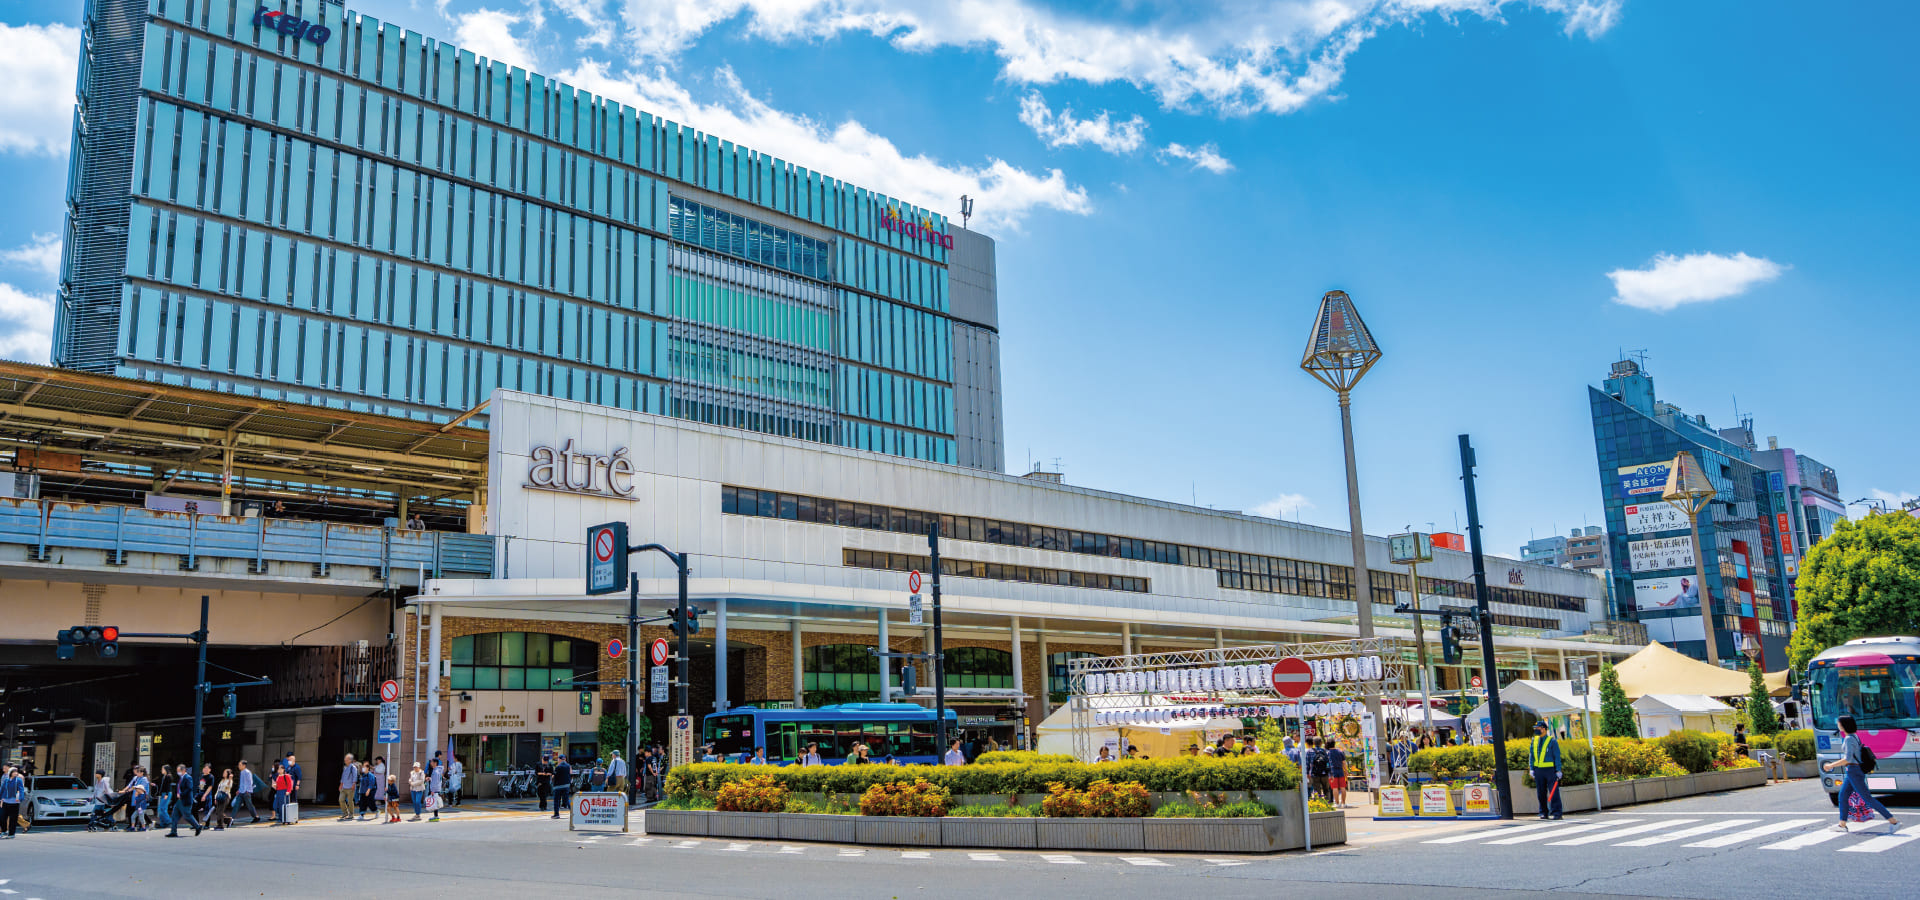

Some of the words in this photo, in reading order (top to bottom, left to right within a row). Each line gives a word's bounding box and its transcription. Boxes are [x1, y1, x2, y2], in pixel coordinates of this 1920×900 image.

[252, 5, 331, 46] KEIO
[880, 204, 954, 251] kirarina
[529, 438, 636, 497] atré
[1637, 465, 1666, 476] AEON
[1629, 521, 1688, 533] セントラルクリニック
[1638, 511, 1678, 524] 吉祥寺
